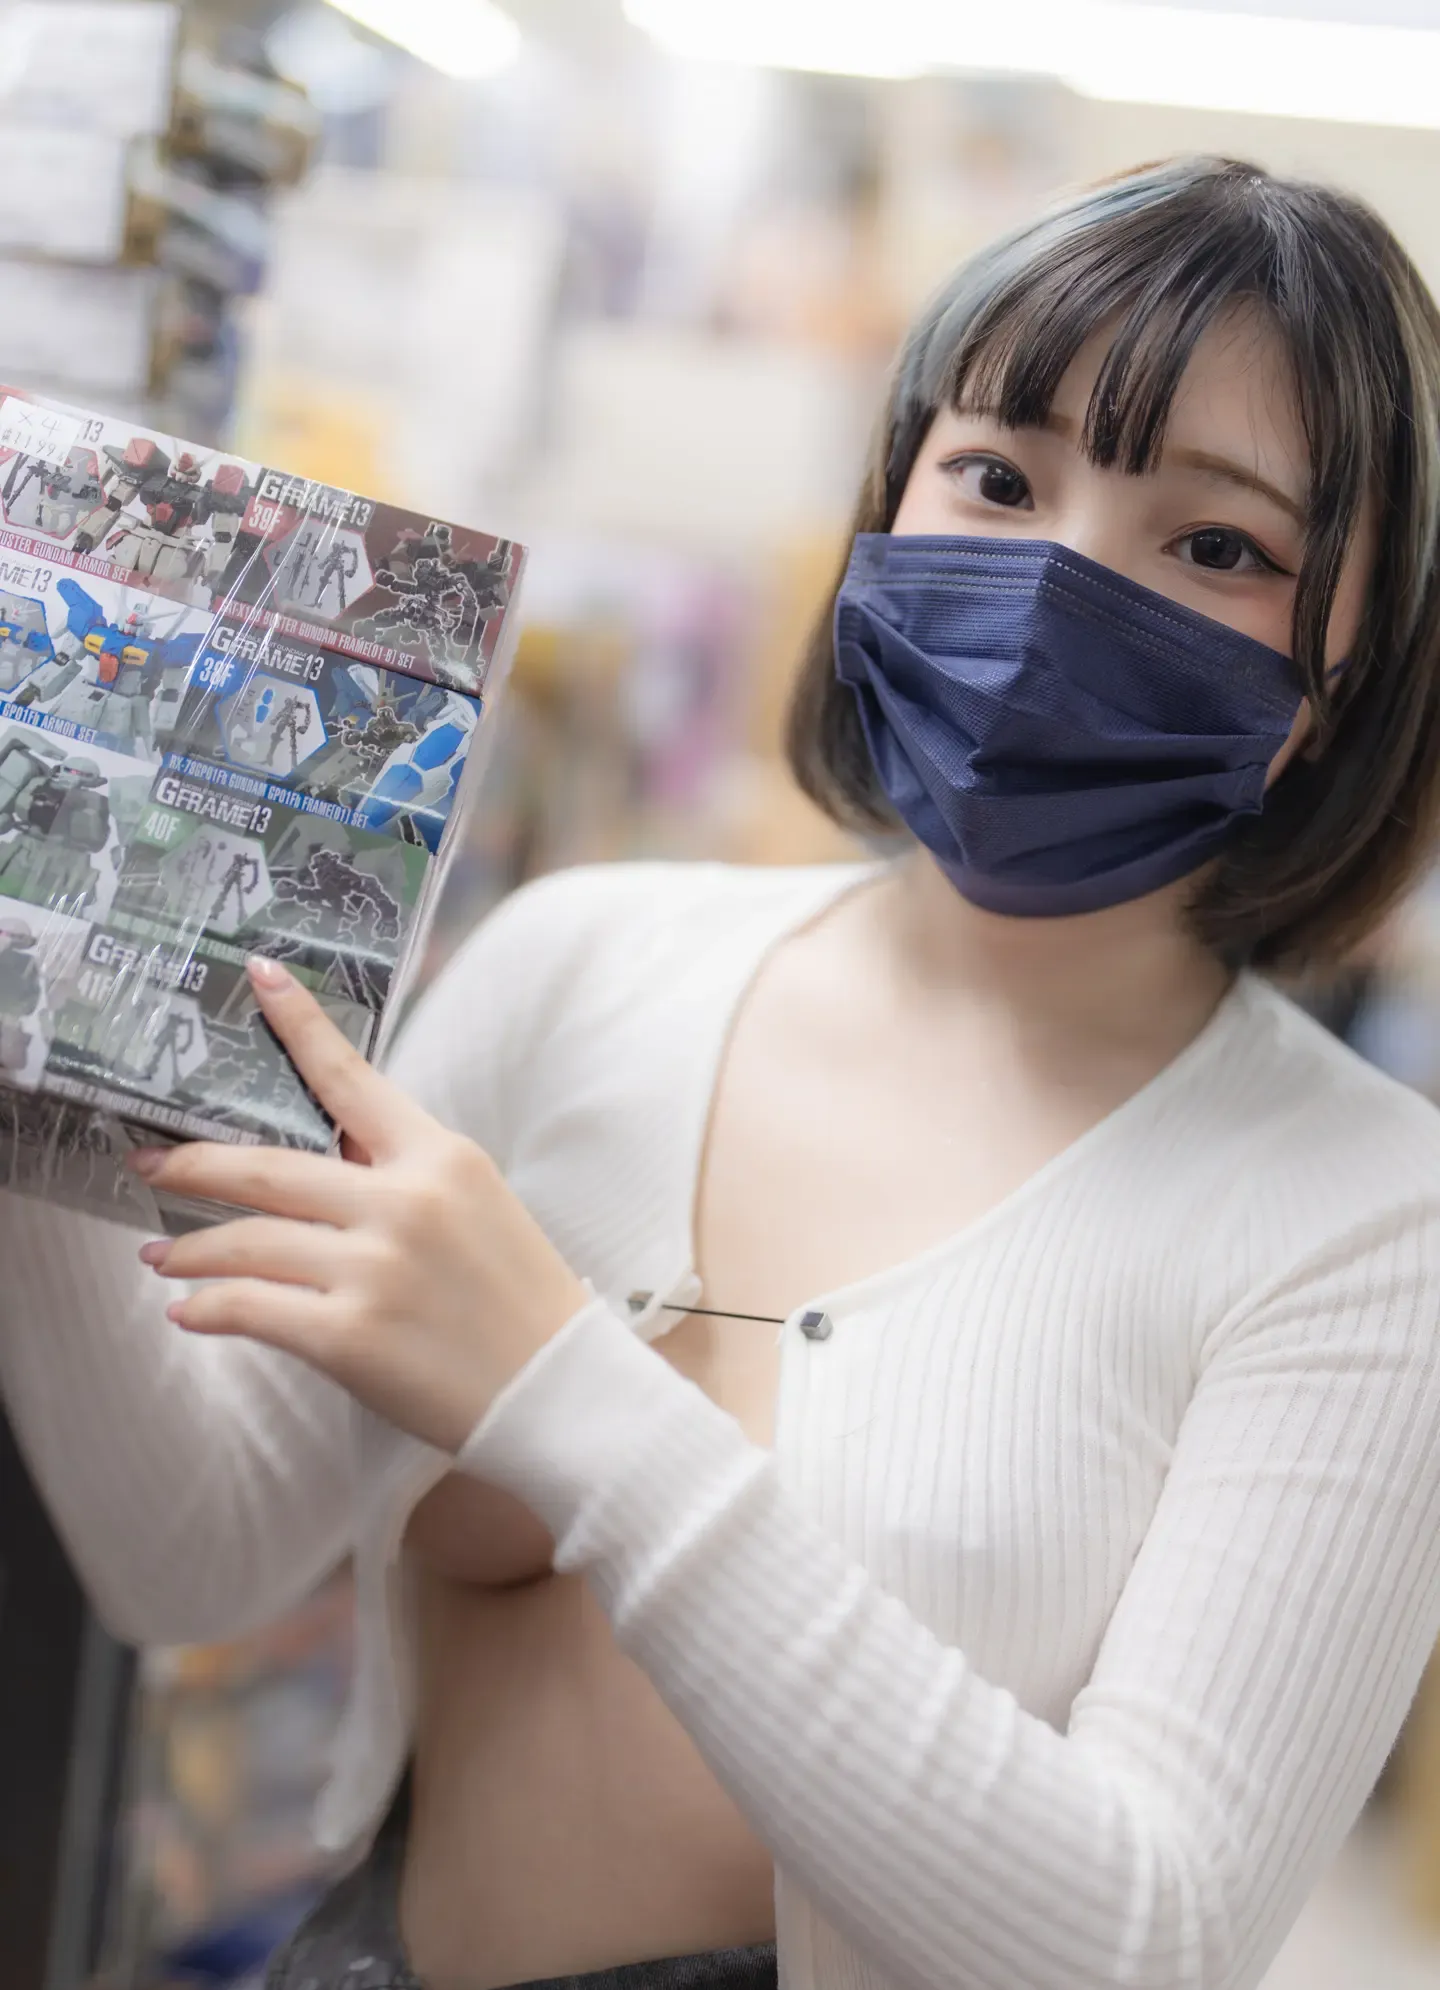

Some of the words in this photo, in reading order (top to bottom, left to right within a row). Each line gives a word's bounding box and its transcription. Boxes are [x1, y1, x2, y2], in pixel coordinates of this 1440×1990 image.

[33, 540, 75, 567] GUNDAM
[76, 553, 111, 577] ARMOR
[112, 565, 133, 583] SET
[211, 626, 325, 681] GFRAME13
[263, 611, 298, 633] BUSTER
[298, 621, 338, 645] GUNDAM
[398, 652, 416, 670] SET
[41, 712, 77, 740] ARMOR
[78, 726, 97, 744] SET
[145, 811, 180, 843] 40F
[156, 777, 272, 834] GFRAME13
[228, 773, 268, 797] GUNDAM
[351, 812, 369, 829] SET
